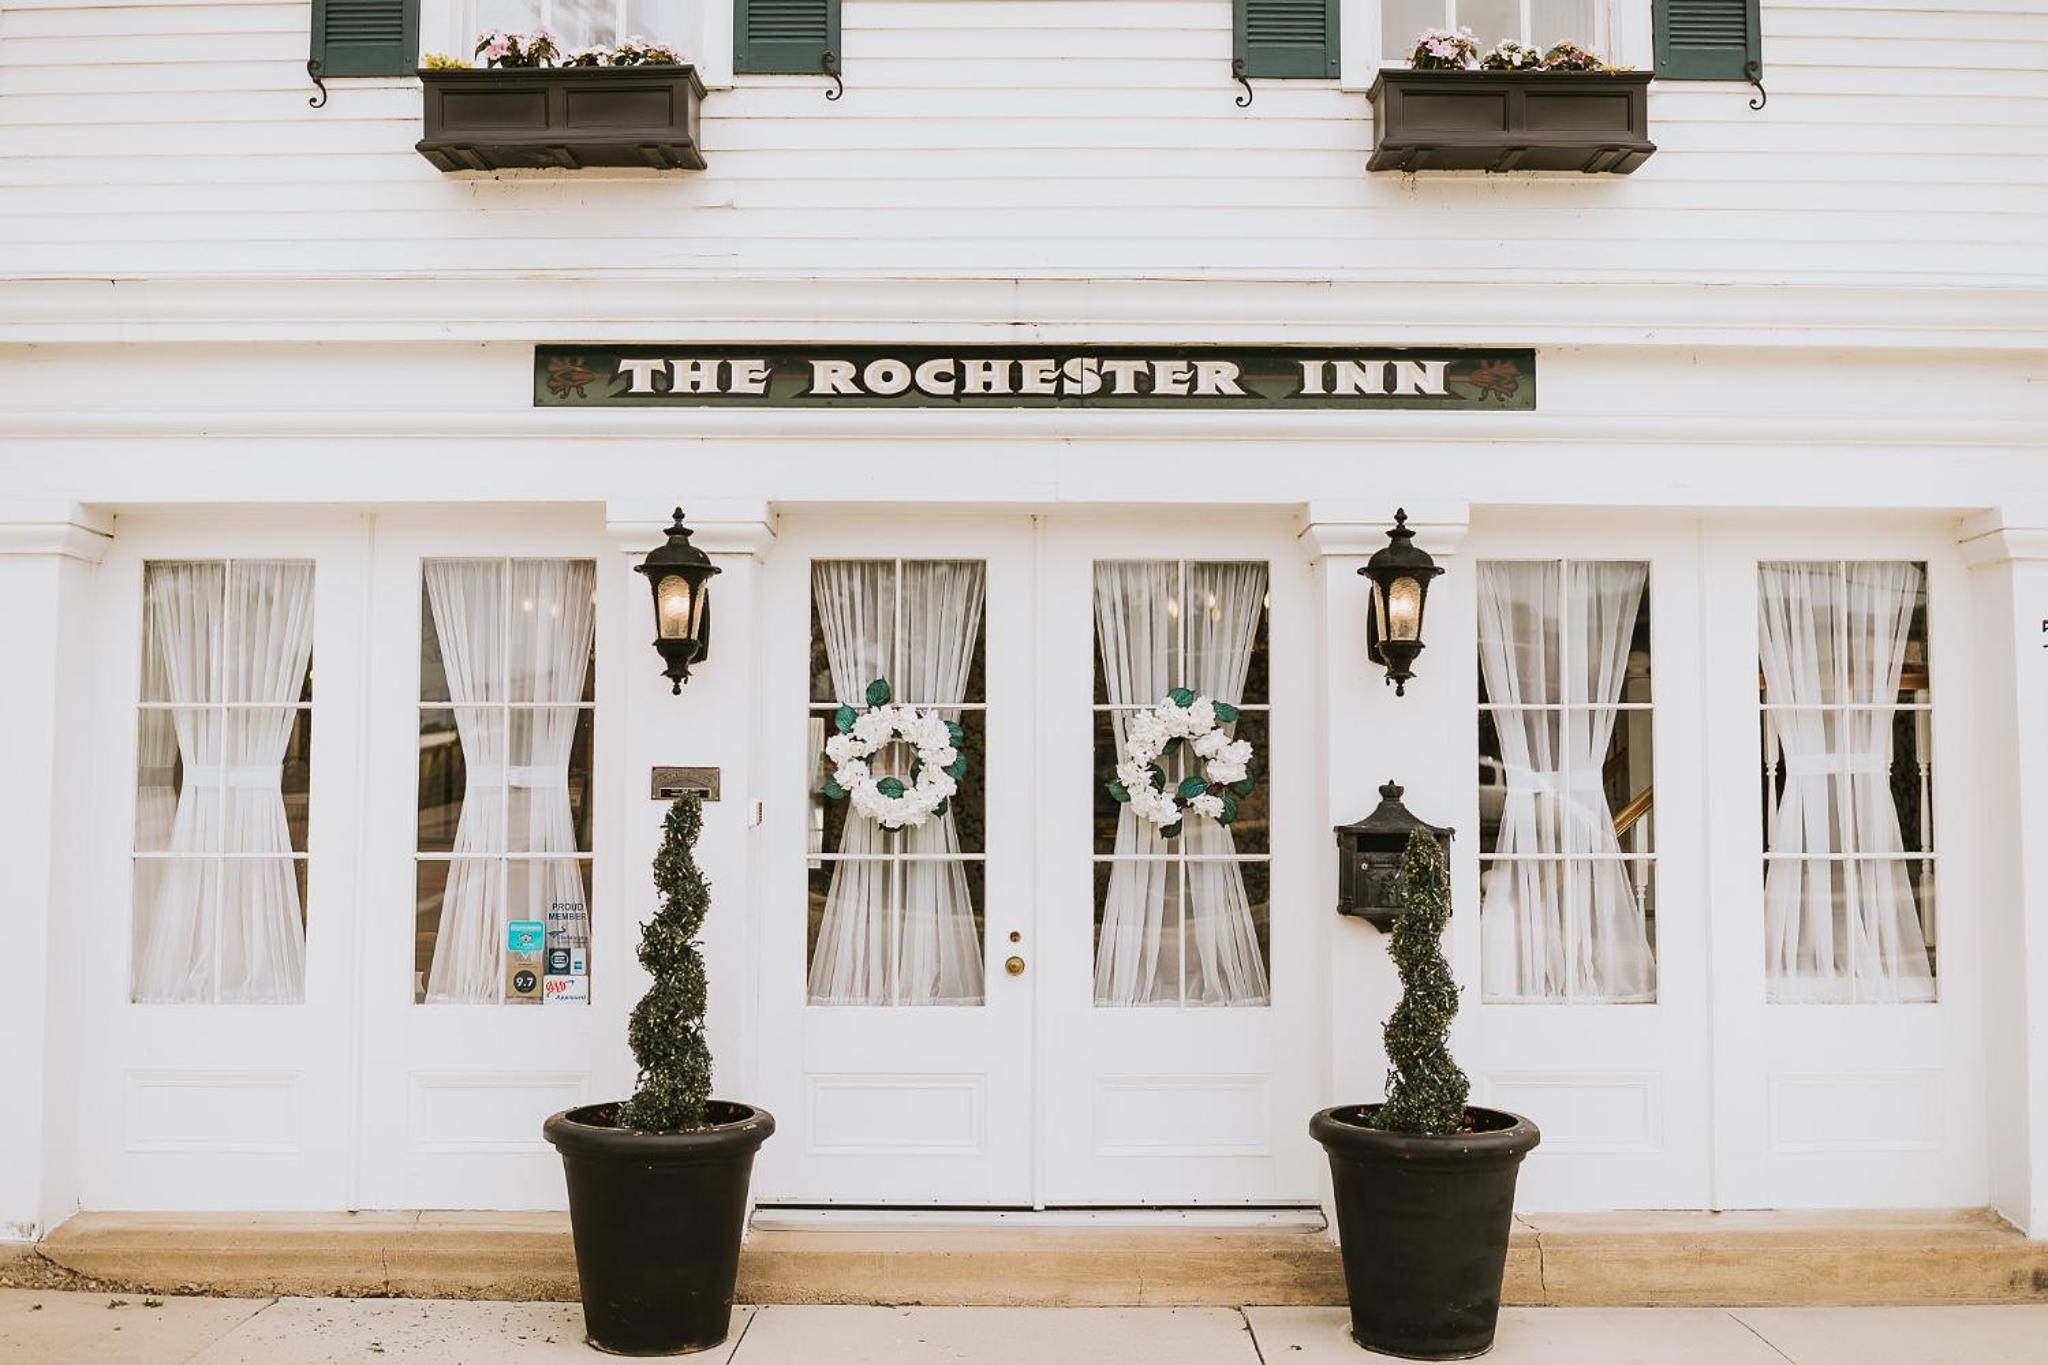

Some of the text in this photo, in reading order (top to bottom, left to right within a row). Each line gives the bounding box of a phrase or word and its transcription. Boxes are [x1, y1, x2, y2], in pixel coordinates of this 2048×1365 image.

[617, 357, 1450, 396] THE ROCHESTER INN
[552, 903, 584, 911] PROUD
[548, 913, 587, 921] MEMBER
[516, 977, 533, 987] 9.7
